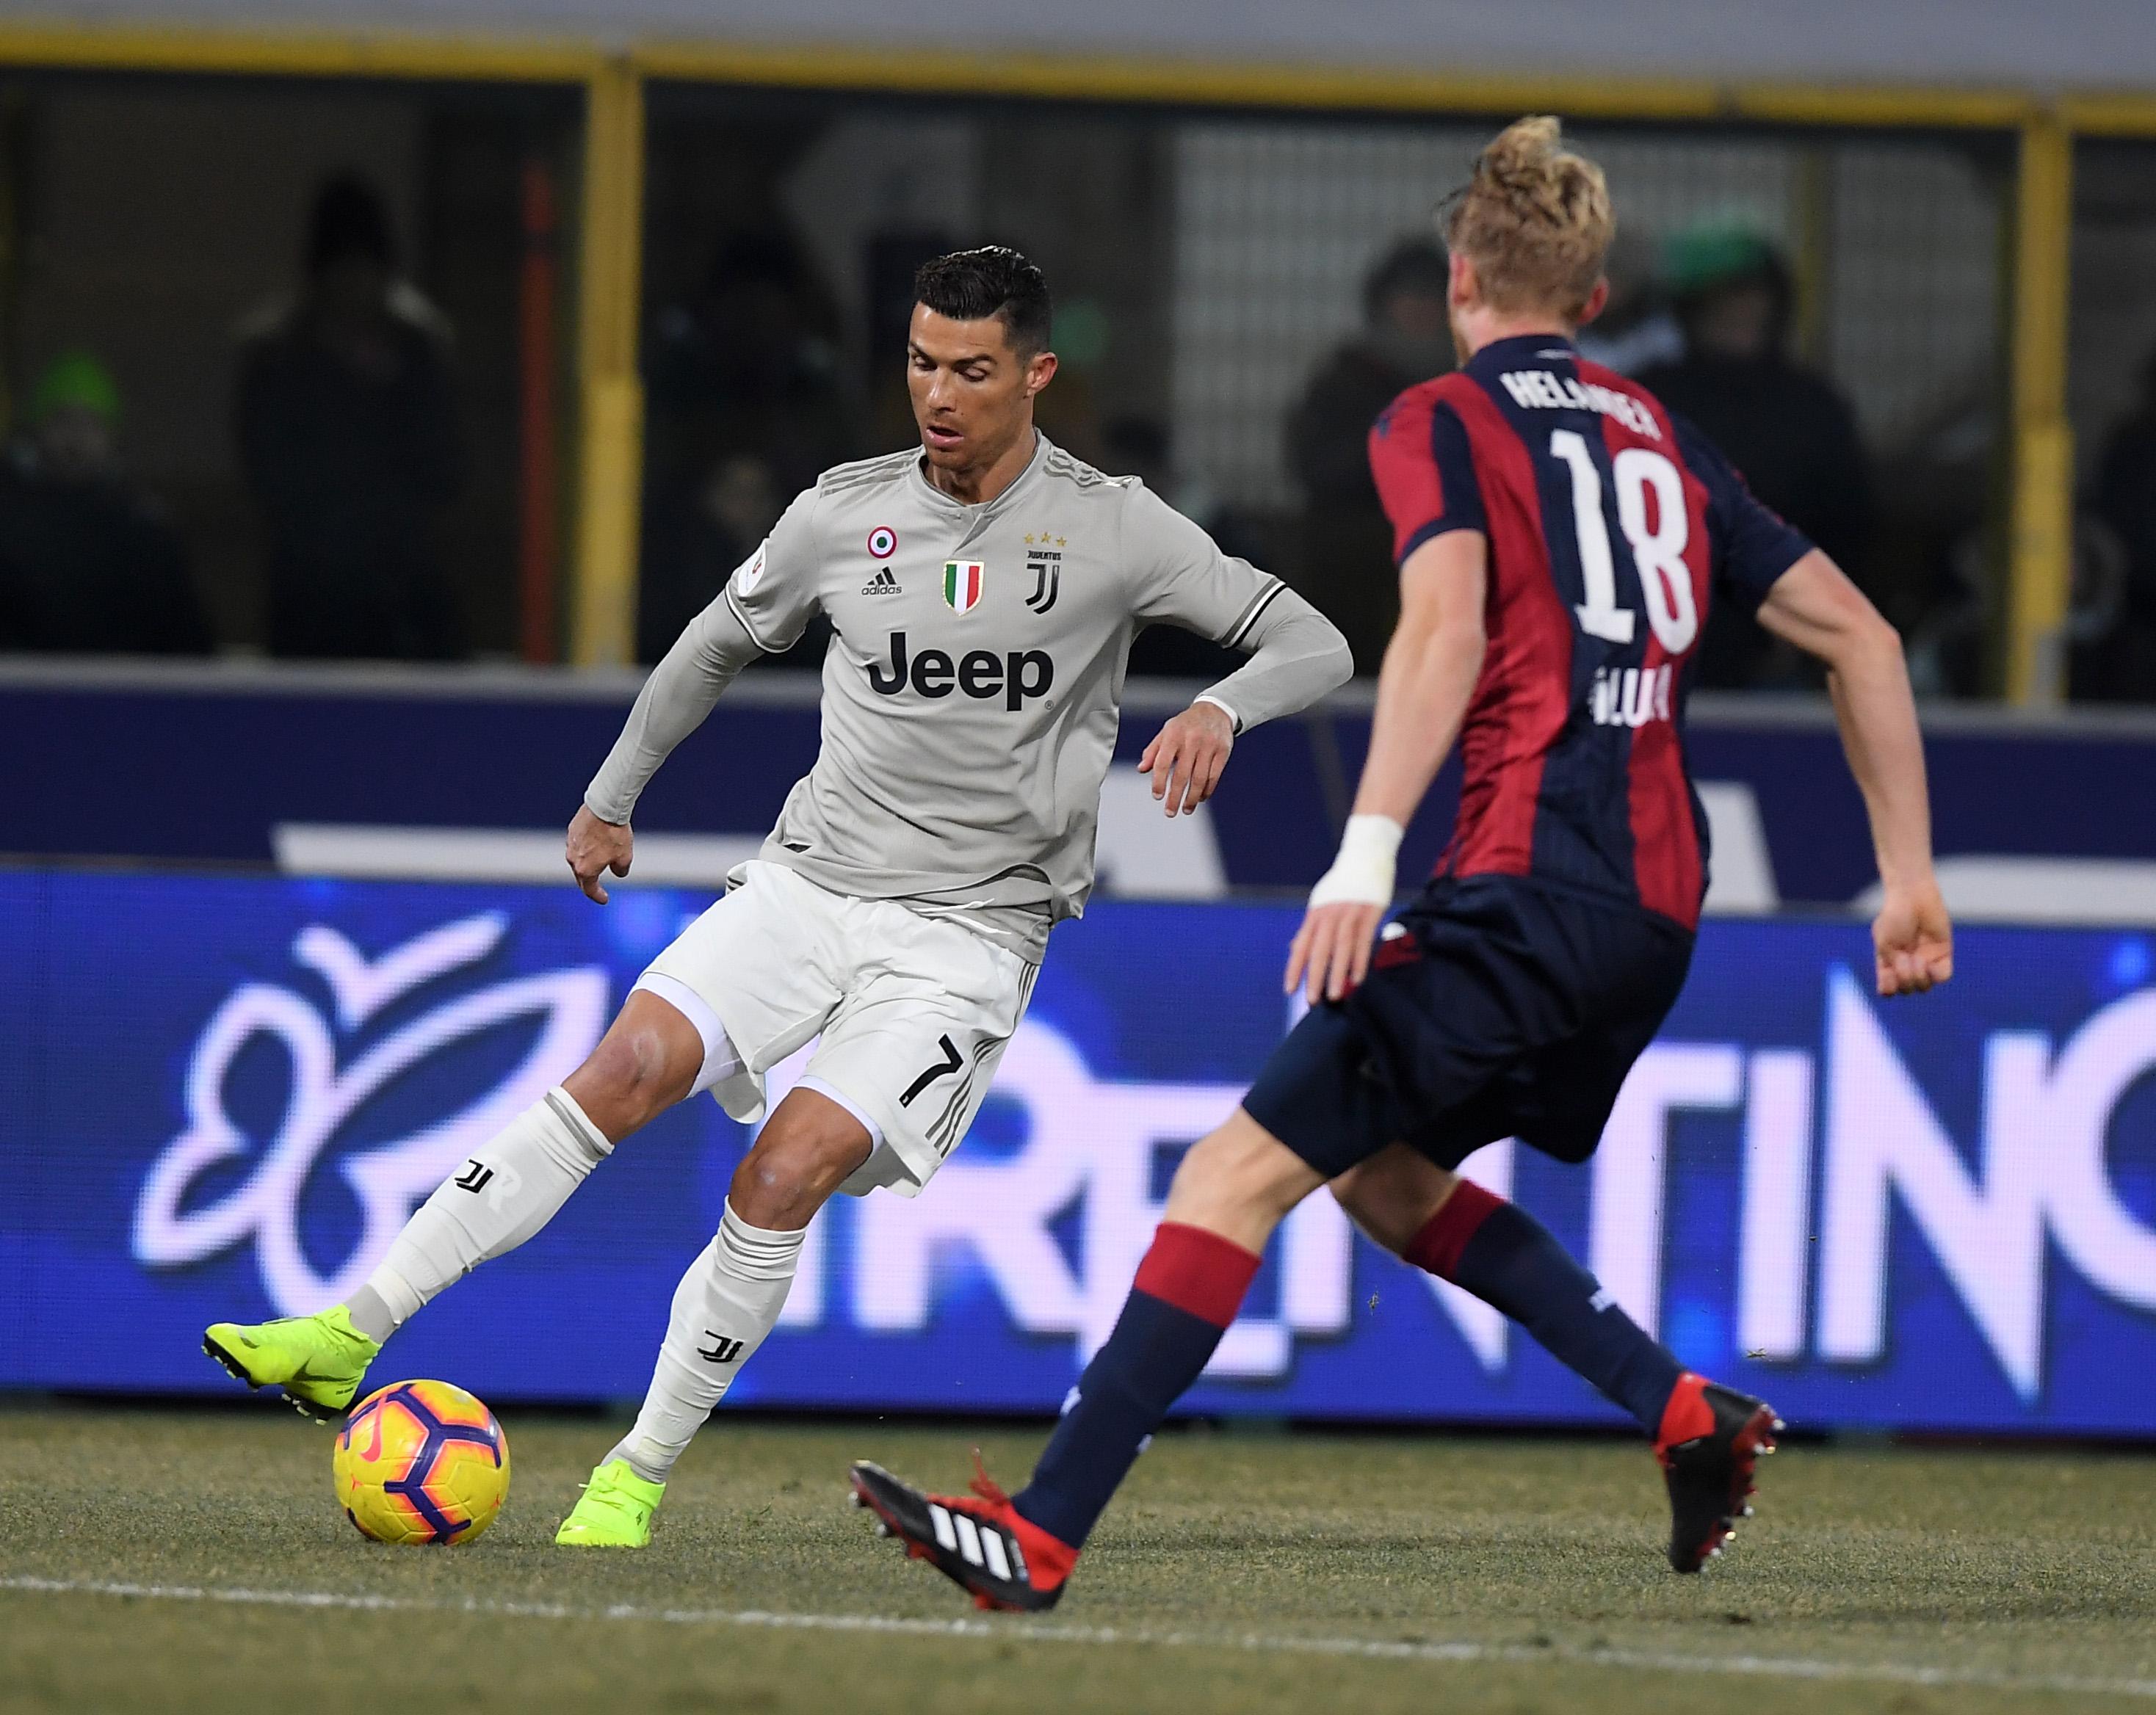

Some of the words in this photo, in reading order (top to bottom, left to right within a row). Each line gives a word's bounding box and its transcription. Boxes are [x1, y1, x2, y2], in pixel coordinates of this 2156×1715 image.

[1027, 550, 1062, 561] JUVENTUS
[1550, 428, 1698, 654] 18
[861, 584, 902, 595] adidas
[866, 631, 1054, 712] Jeep
[899, 1033, 964, 1109] 7
